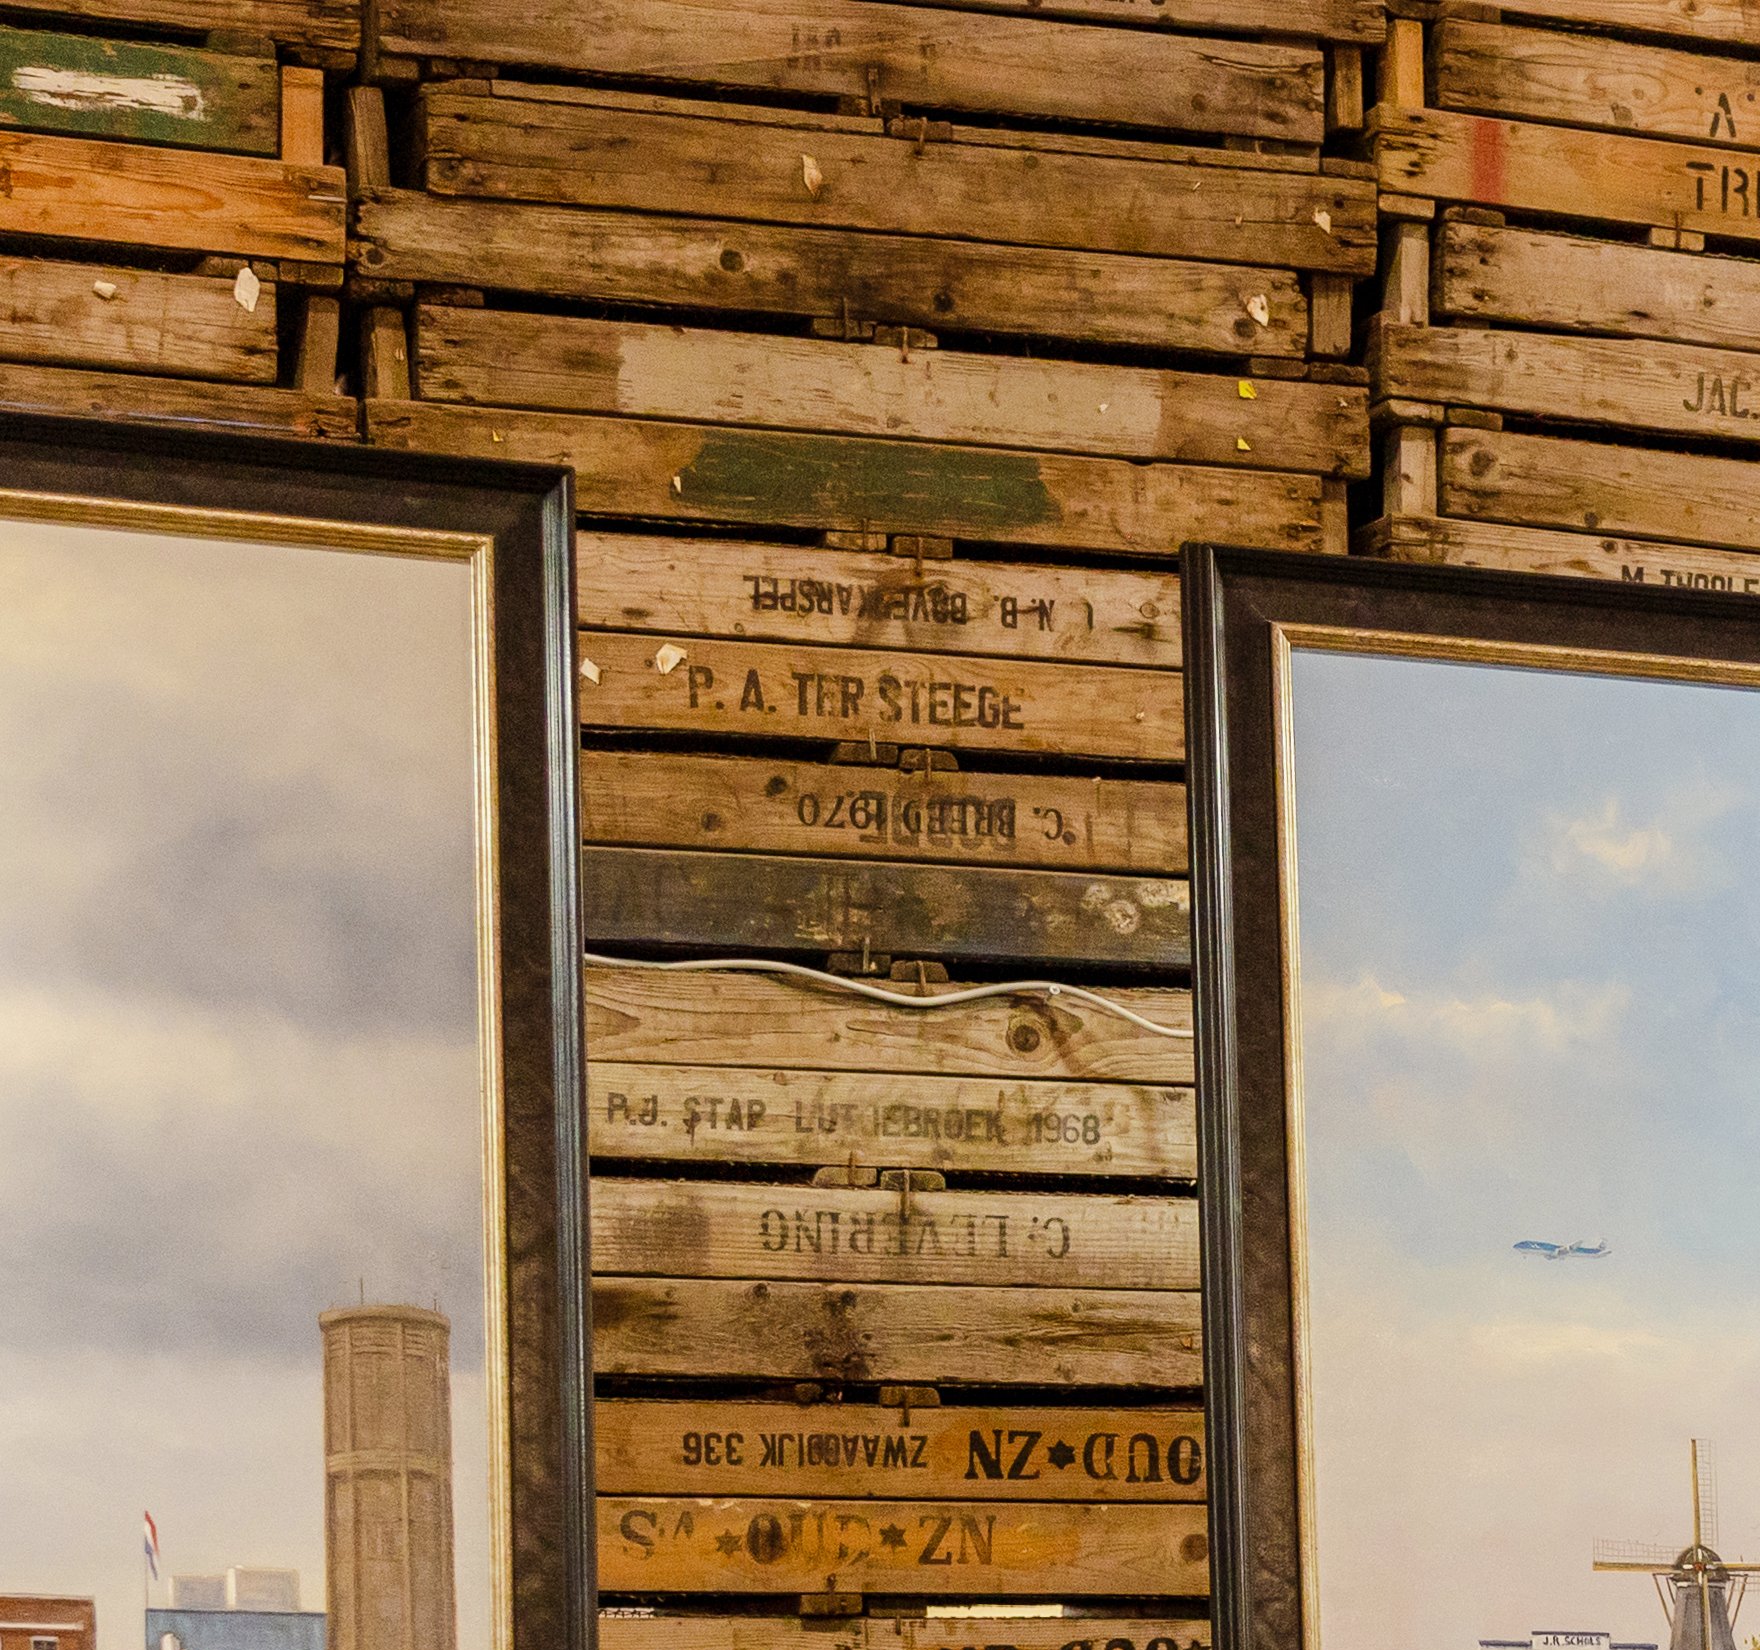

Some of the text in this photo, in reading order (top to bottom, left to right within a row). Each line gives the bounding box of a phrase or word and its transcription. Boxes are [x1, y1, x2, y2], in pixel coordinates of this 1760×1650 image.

[687, 664, 1026, 730] P. A. TER STEEGE
[681, 1431, 746, 1467] 336
[963, 1428, 1043, 1481] ZN
[1083, 1431, 1201, 1486] OUD
[917, 1513, 997, 1566] ZN
